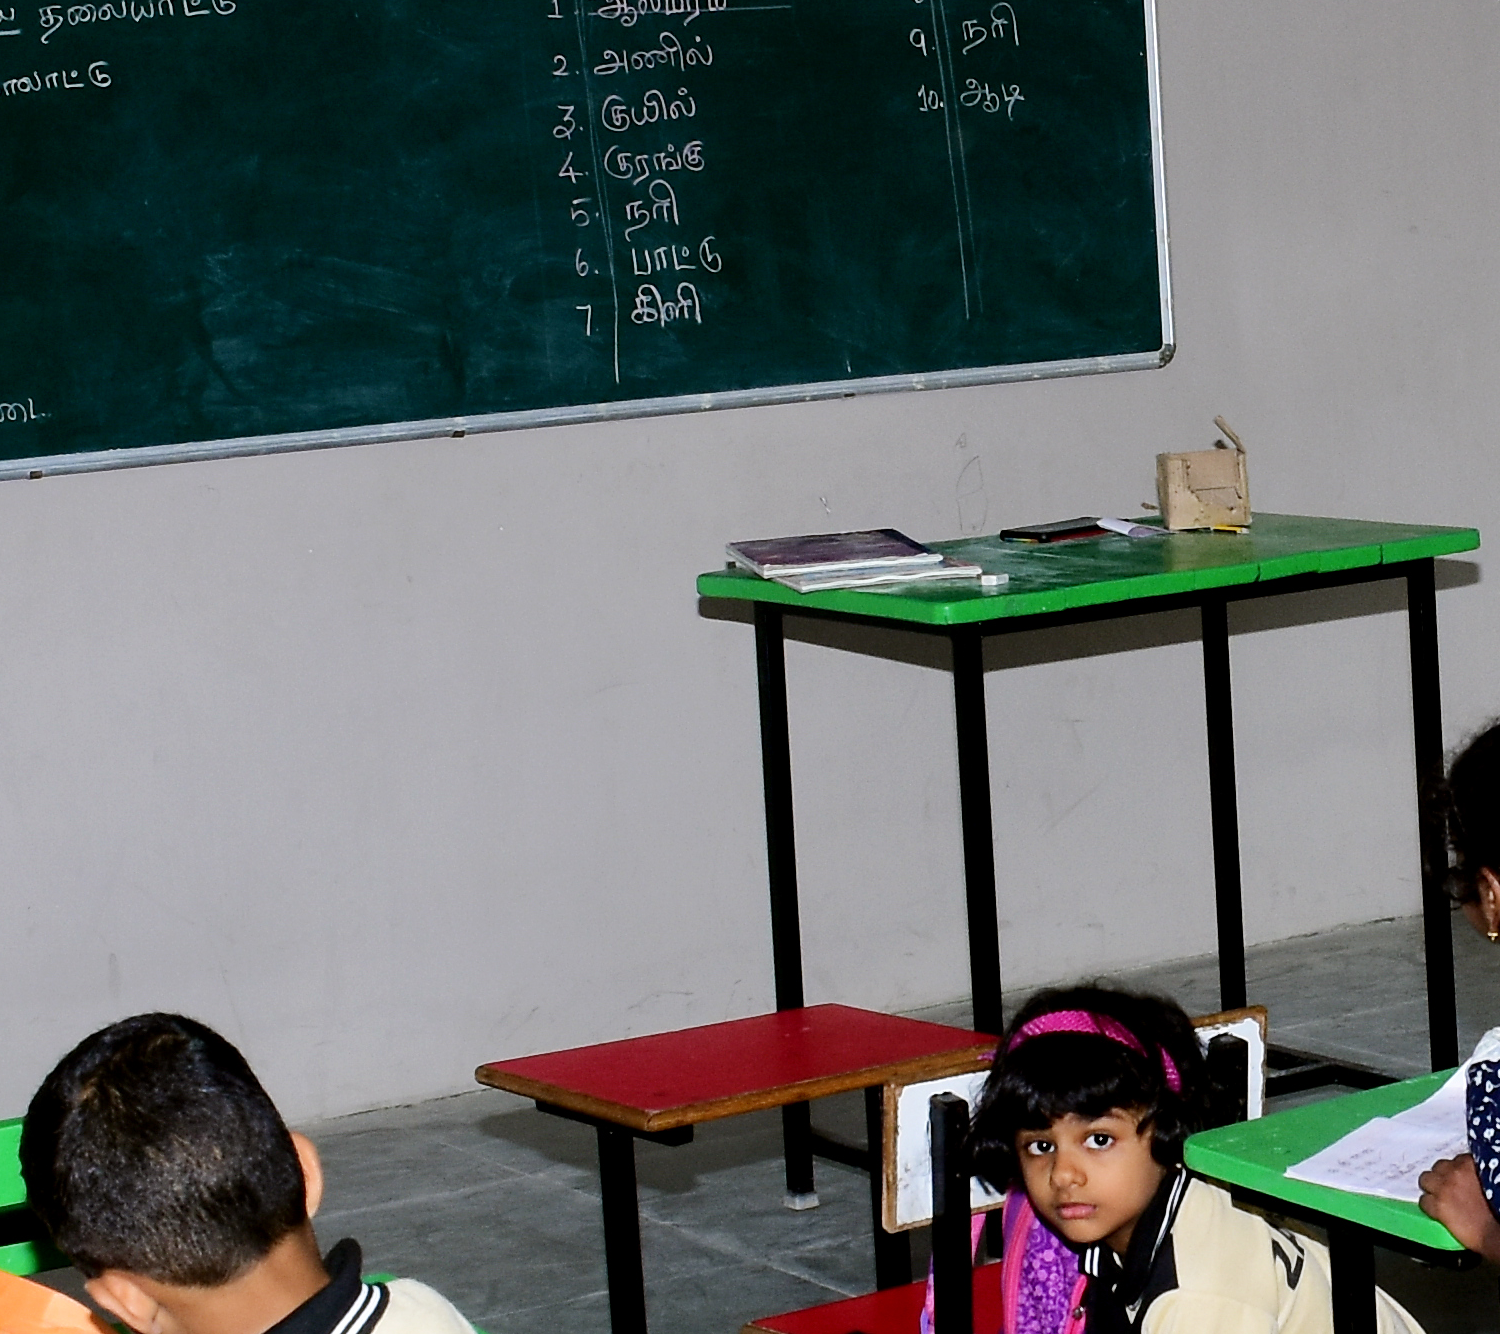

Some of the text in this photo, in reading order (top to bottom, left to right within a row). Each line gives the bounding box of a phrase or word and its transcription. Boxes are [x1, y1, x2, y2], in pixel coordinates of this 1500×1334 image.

[962, 2, 1019, 55] நரி
[593, 31, 713, 75] அணில்
[602, 87, 697, 131] குயில்
[960, 78, 1025, 121] ஆடி
[604, 140, 705, 186] குரங்கு
[625, 179, 679, 242] நரி
[632, 236, 722, 275] பாட்டு
[631, 282, 702, 328] கிளி
